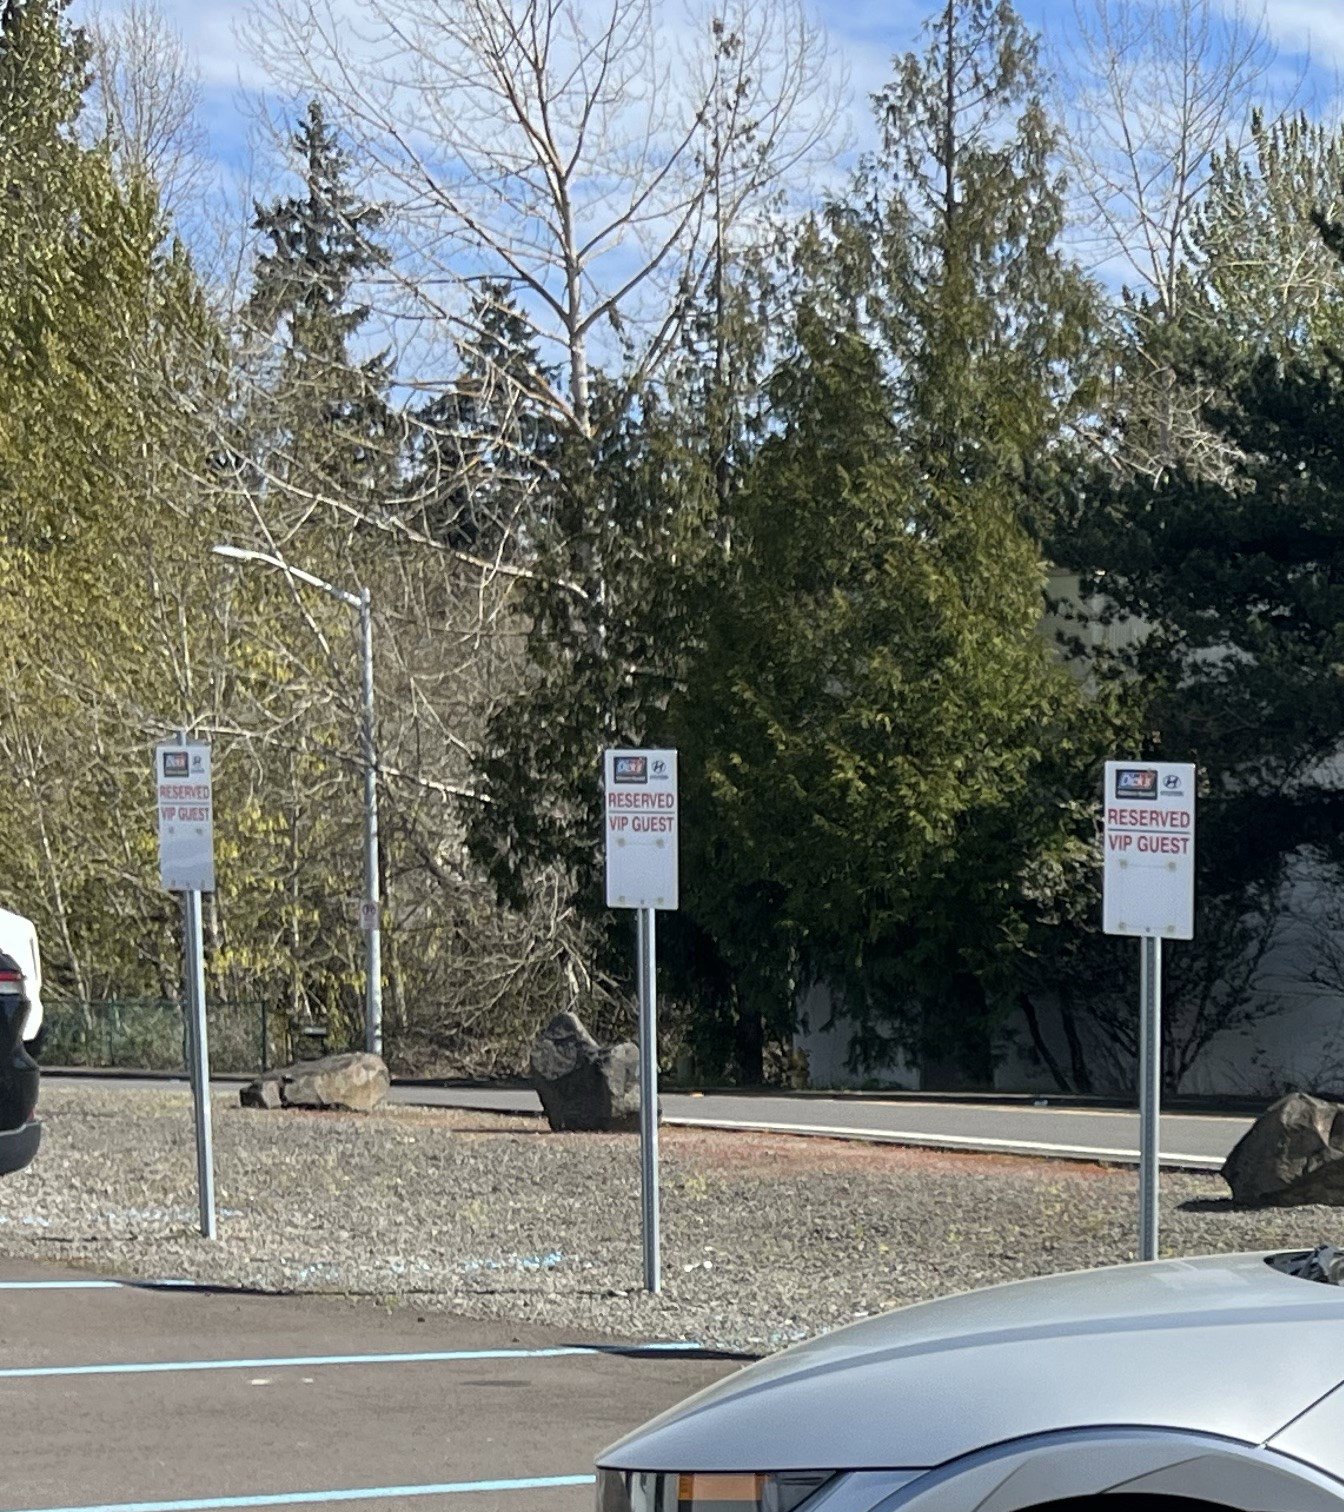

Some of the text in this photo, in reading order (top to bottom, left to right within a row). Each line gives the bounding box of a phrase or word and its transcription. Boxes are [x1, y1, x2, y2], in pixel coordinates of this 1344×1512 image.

[159, 784, 211, 800] RESERVED
[608, 792, 675, 809] RESERVED
[160, 806, 210, 822] VIP GUEST
[1108, 808, 1190, 829] RESERVED
[609, 815, 675, 833] VIP GUEST
[1108, 834, 1190, 855] VIP GUEST
